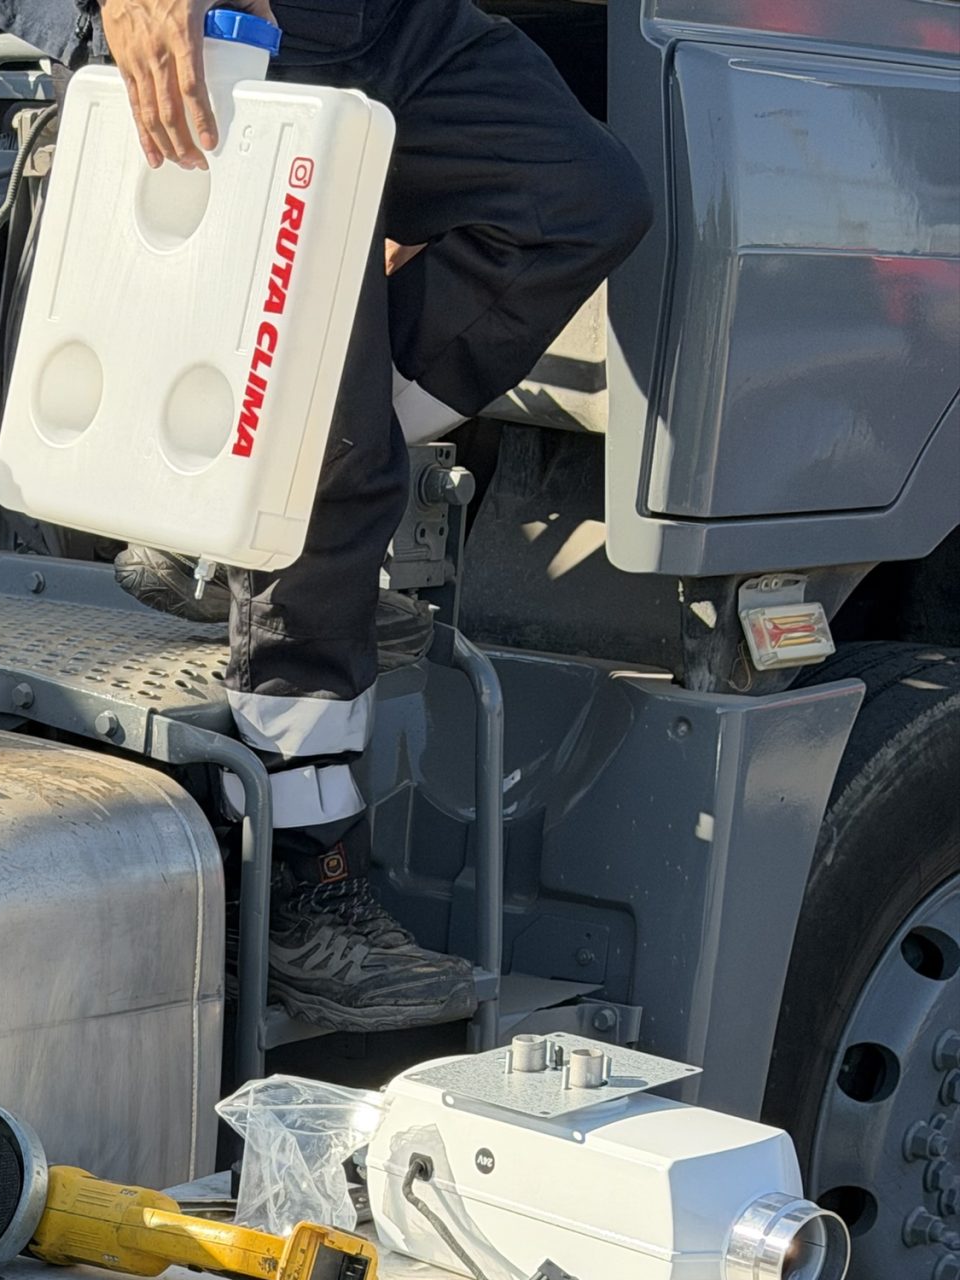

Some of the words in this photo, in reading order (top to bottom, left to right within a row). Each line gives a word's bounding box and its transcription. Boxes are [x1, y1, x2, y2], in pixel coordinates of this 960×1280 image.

[263, 193, 305, 315] RUTA
[231, 321, 279, 458] CLIMA
[477, 1155, 493, 1168] 24V
